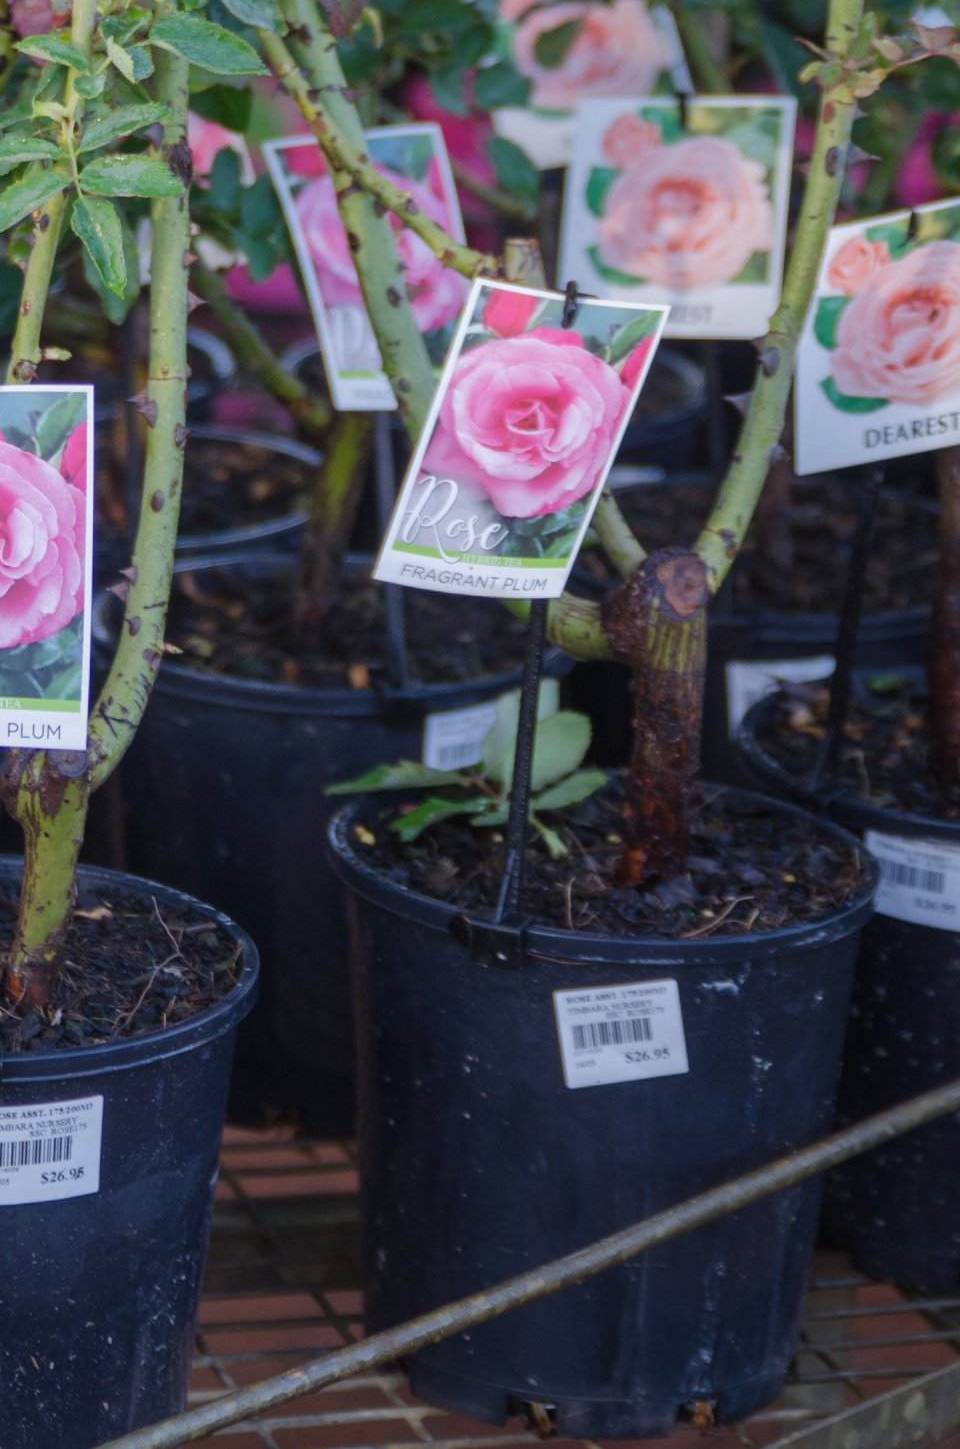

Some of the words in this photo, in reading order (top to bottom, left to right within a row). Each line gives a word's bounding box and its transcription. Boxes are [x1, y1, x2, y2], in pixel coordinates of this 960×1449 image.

[864, 411, 960, 449] DEAREST
[401, 475, 510, 564] Rose
[400, 564, 501, 590] FRAGRANT
[502, 577, 549, 592] PLUM
[7, 722, 62, 741] PLUM
[624, 1048, 671, 1064] $26.95
[19, 1109, 47, 1119] ASST.
[35, 1116, 79, 1129] NURSERY
[40, 1166, 85, 1184] $26.95
